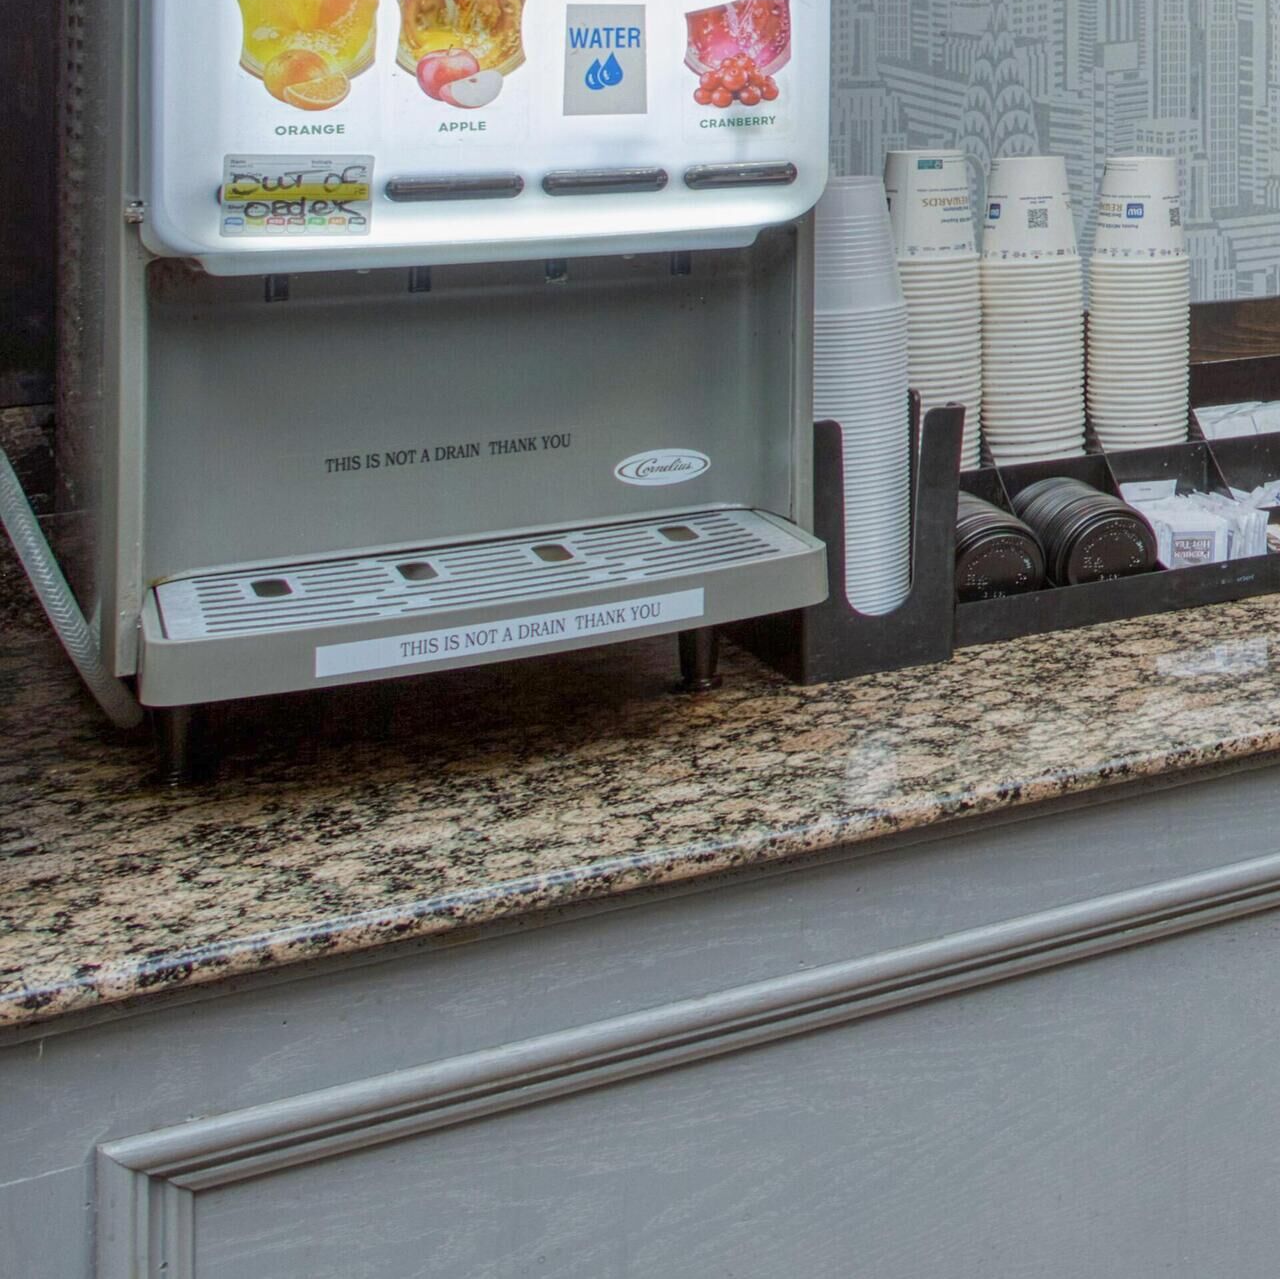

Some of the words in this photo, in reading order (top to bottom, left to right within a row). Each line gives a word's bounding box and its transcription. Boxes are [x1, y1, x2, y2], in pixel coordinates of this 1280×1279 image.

[569, 27, 642, 49] WATER
[274, 124, 345, 136] ORANGE
[438, 120, 487, 133] APPLE
[699, 116, 776, 129] CRANBERRY
[325, 456, 361, 473] THIS
[366, 453, 380, 469] IS
[384, 449, 417, 467] NOT
[420, 448, 430, 463] A
[434, 442, 480, 461] DRAIN
[488, 437, 537, 455] THANK
[541, 433, 571, 450] YOU
[635, 458, 692, 477] Cornelius
[401, 638, 439, 658] THIS
[444, 635, 460, 651] IS
[465, 629, 498, 648] NOT
[502, 627, 513, 642] A
[518, 618, 566, 640] DRAIN
[575, 608, 626, 631] THANK
[630, 602, 661, 622] YOU
